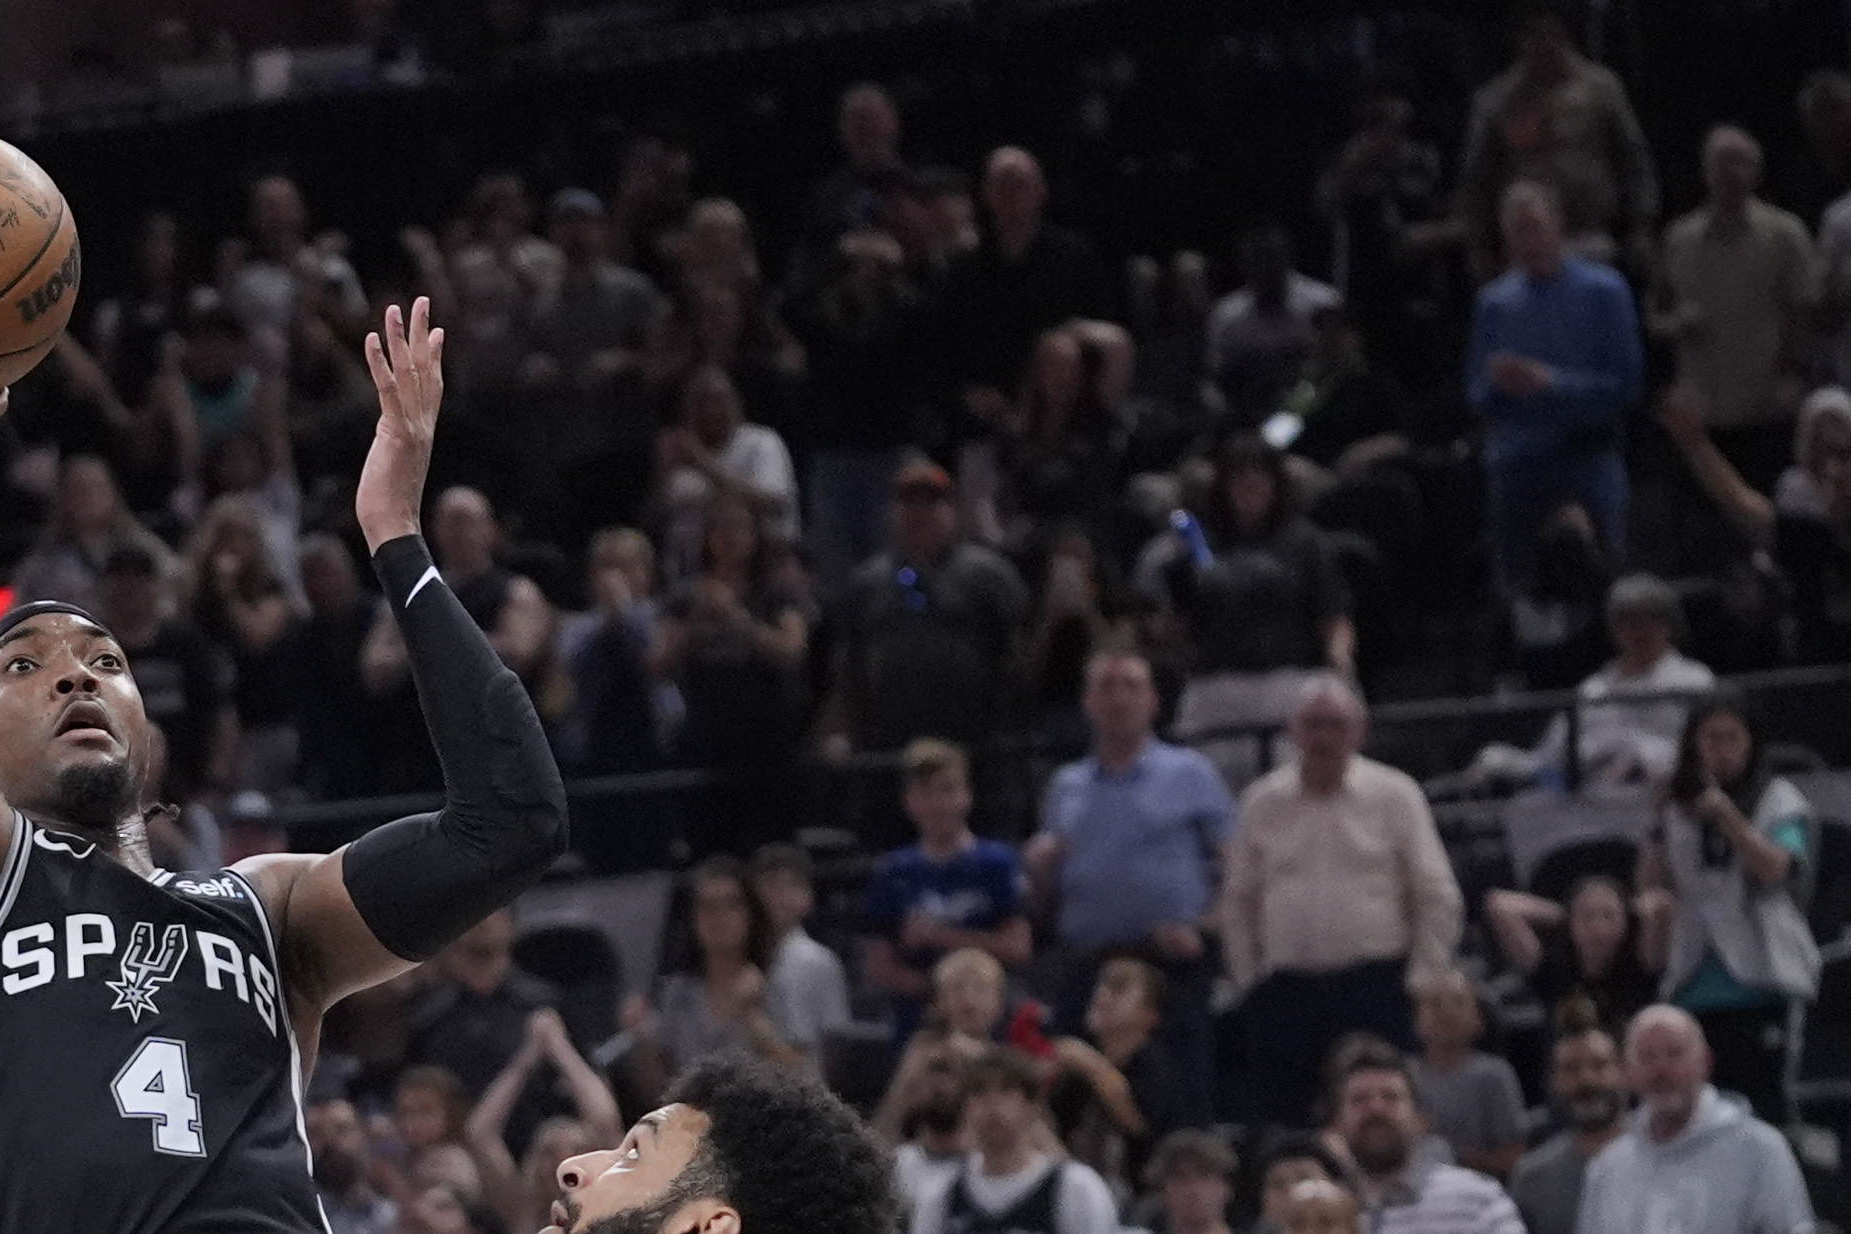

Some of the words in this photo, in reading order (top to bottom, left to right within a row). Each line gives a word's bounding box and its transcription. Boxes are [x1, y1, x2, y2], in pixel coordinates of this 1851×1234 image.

[175, 877, 244, 899] Self.
[2, 913, 278, 1038] SPURS
[110, 1036, 207, 1158] 4
